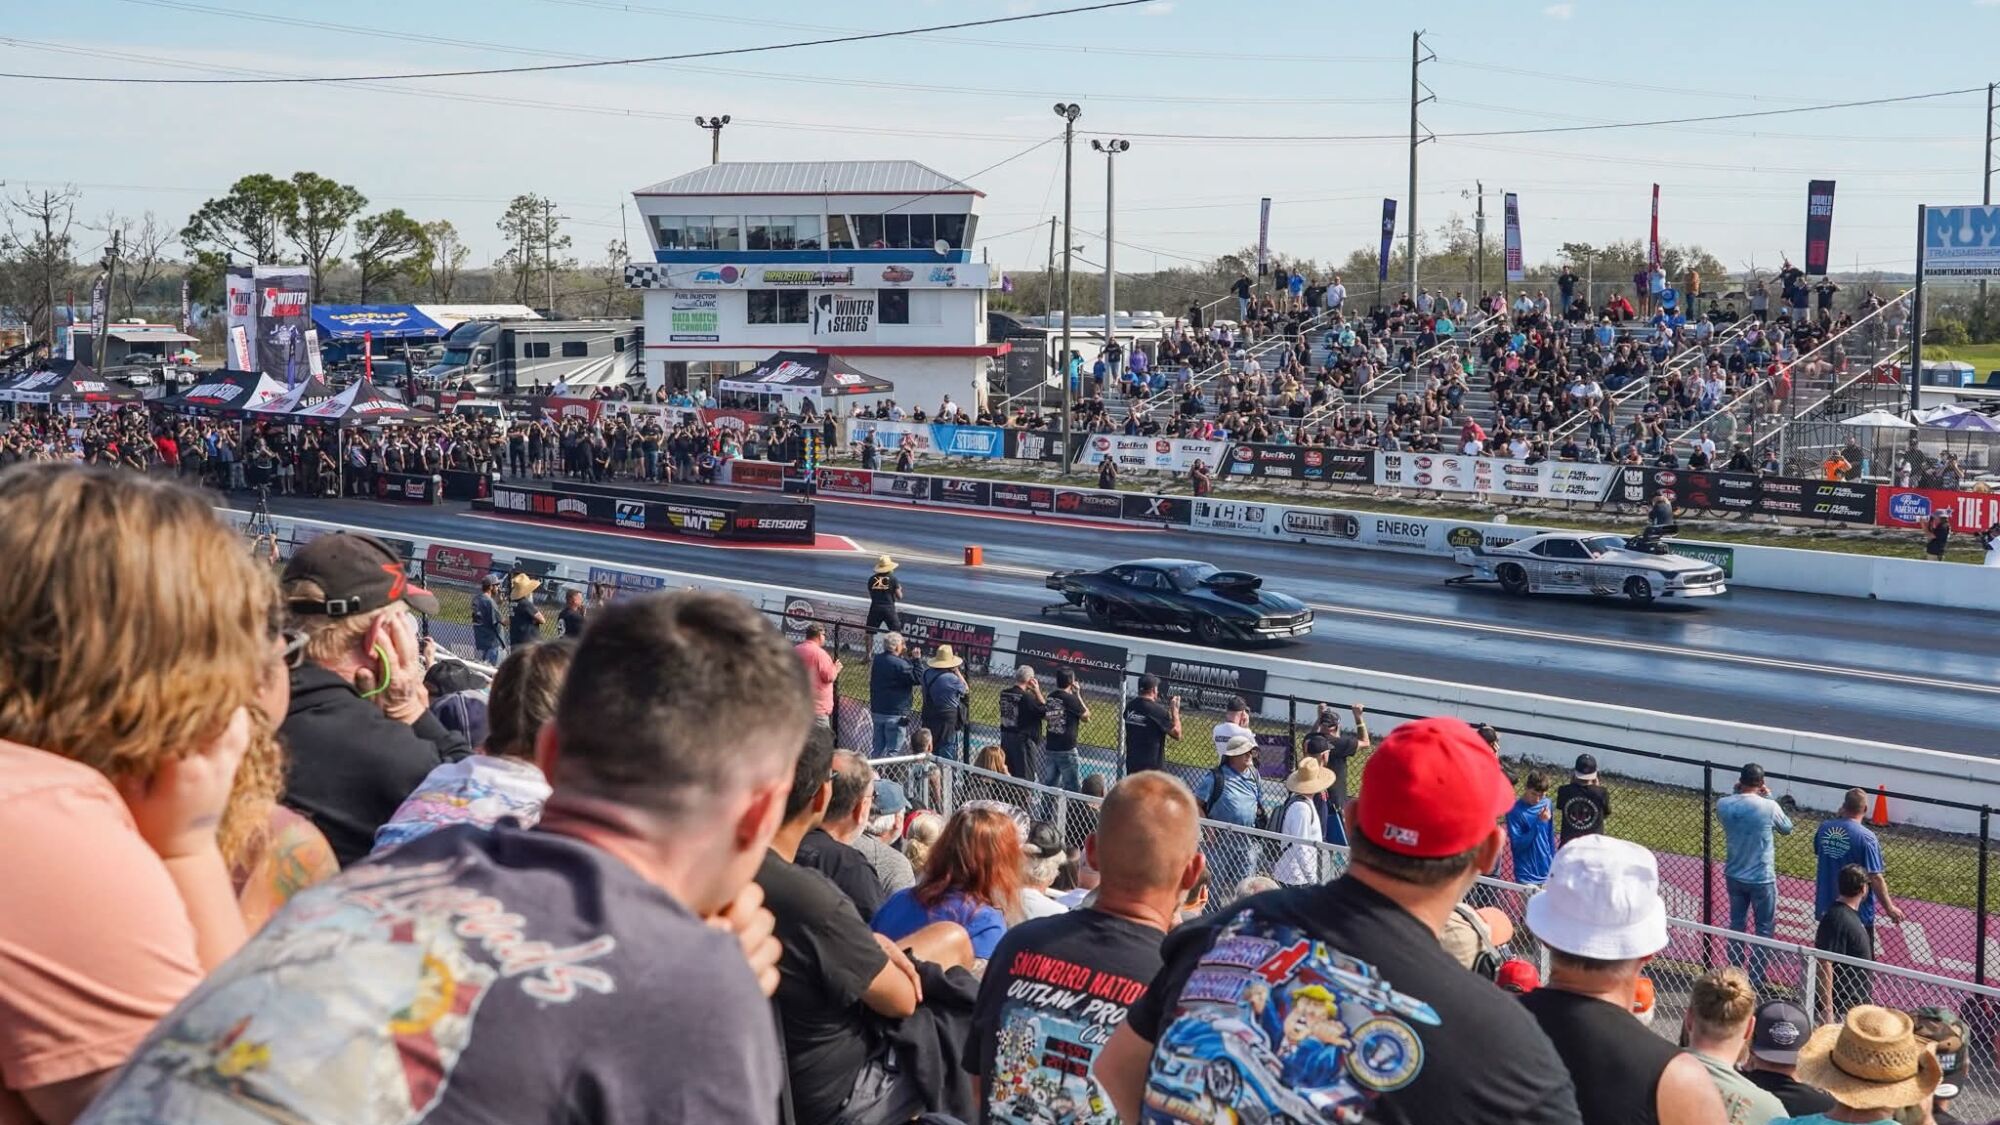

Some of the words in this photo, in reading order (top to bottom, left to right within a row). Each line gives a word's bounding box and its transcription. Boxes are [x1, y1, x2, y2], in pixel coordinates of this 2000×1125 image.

[276, 292, 308, 305] WINTER
[695, 300, 717, 308] CLINIC
[835, 300, 875, 316] WINTER
[672, 313, 690, 323] DATA
[832, 316, 869, 333] SERIES
[672, 323, 717, 332] TECHNOLOGY
[956, 434, 990, 449] STROUD
[1260, 450, 1296, 460] FuelTech
[1333, 455, 1366, 463] ELITE
[1832, 490, 1867, 499] FACTORY
[668, 505, 691, 514] MICKEY
[691, 508, 726, 518] THOMPSON
[1829, 507, 1863, 516] FACTORY
[1893, 505, 1927, 515] AMERICAN
[1957, 497, 1983, 529] THE
[615, 519, 645, 529] CARRILLO
[757, 519, 808, 530] SENSORS
[1212, 519, 1236, 529] CHRISTIAN
[1286, 514, 1330, 527] braille
[1376, 518, 1430, 538] ENERGY
[1451, 536, 1481, 547] CALLIES
[1698, 553, 1730, 567] SIGNS
[916, 617, 940, 626] ACCIDENT
[945, 621, 963, 631] INJURY
[964, 624, 976, 633] LAW
[1062, 655, 1122, 671] RACEWORKS
[1169, 661, 1240, 689] EDMUNDS
[1255, 939, 1309, 987] 4
[1009, 951, 1092, 991] SNOWBIRD
[1007, 979, 1088, 1011] OUTLAW
[1081, 1001, 1128, 1024] PRO
